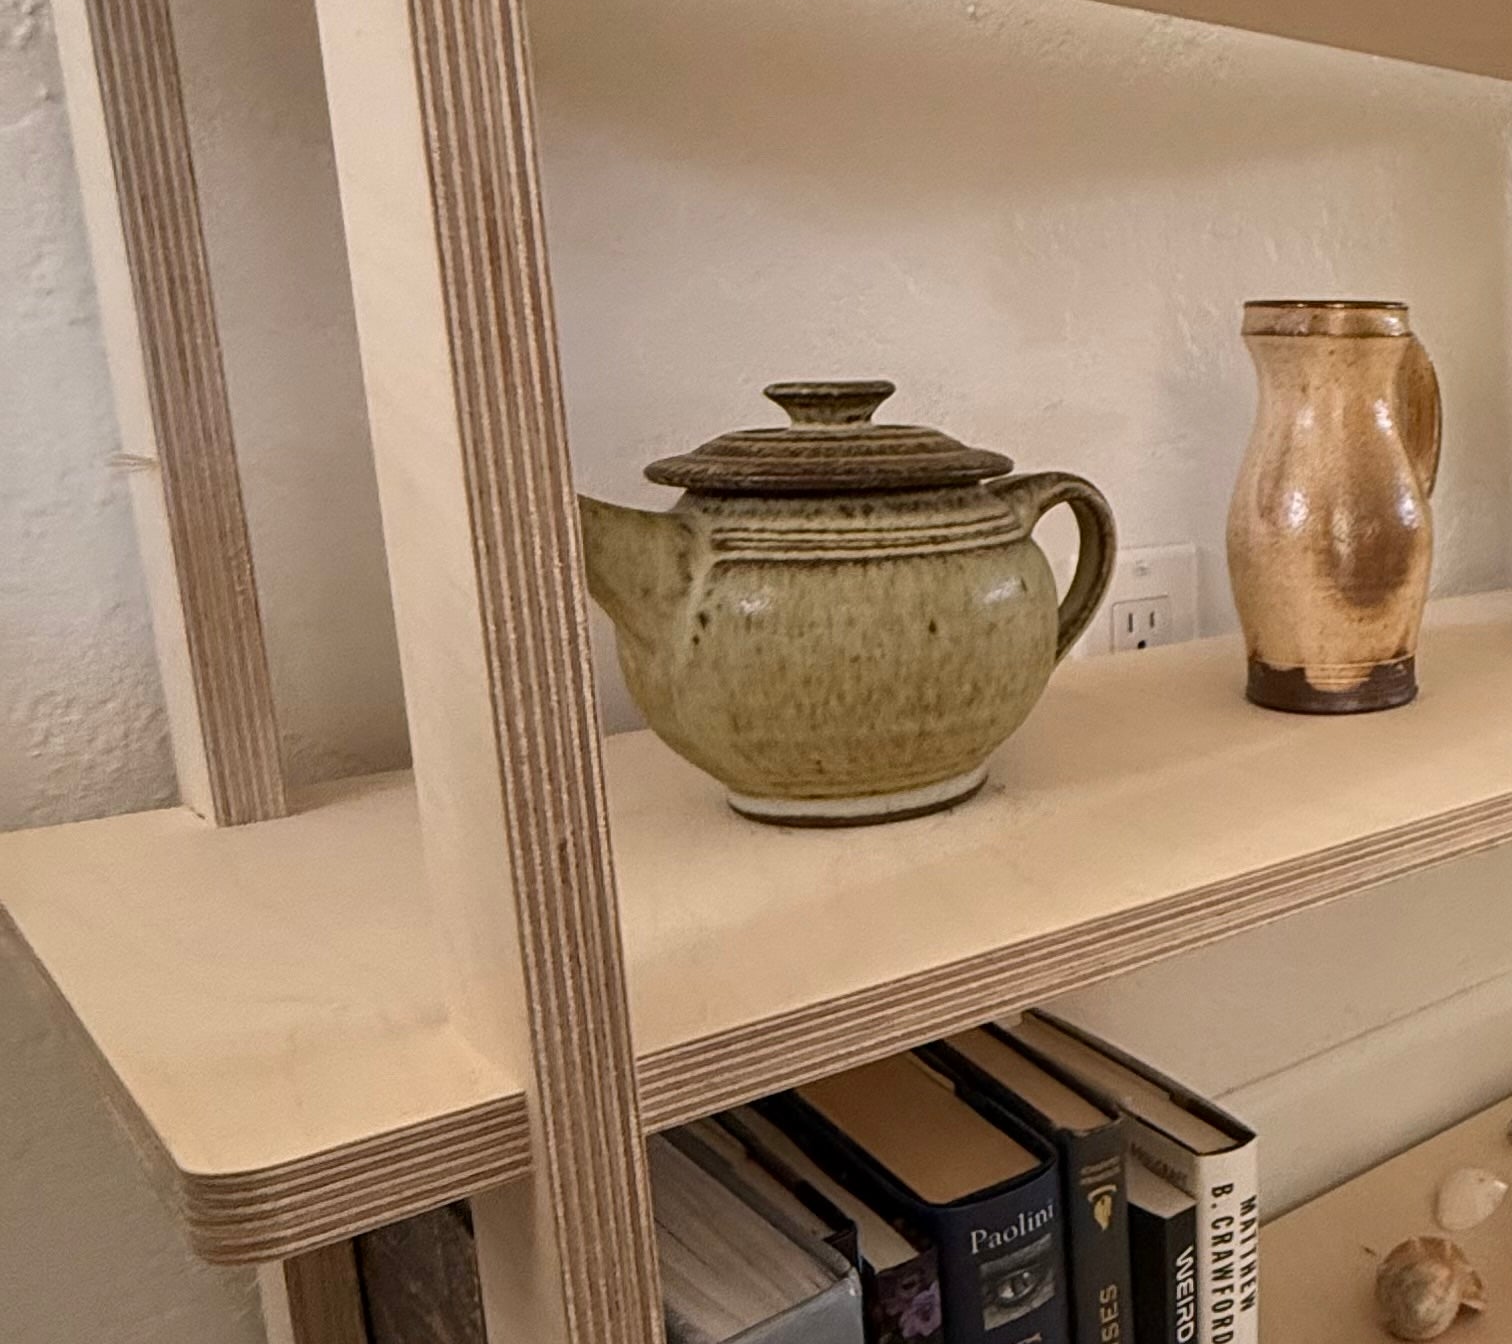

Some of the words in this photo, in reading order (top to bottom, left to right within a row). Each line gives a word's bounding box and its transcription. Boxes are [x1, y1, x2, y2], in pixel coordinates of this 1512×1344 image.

[970, 1199, 1054, 1255] Paolini
[1240, 1195, 1257, 1312] MATTHEW
[1176, 1246, 1194, 1344] WEIRD
